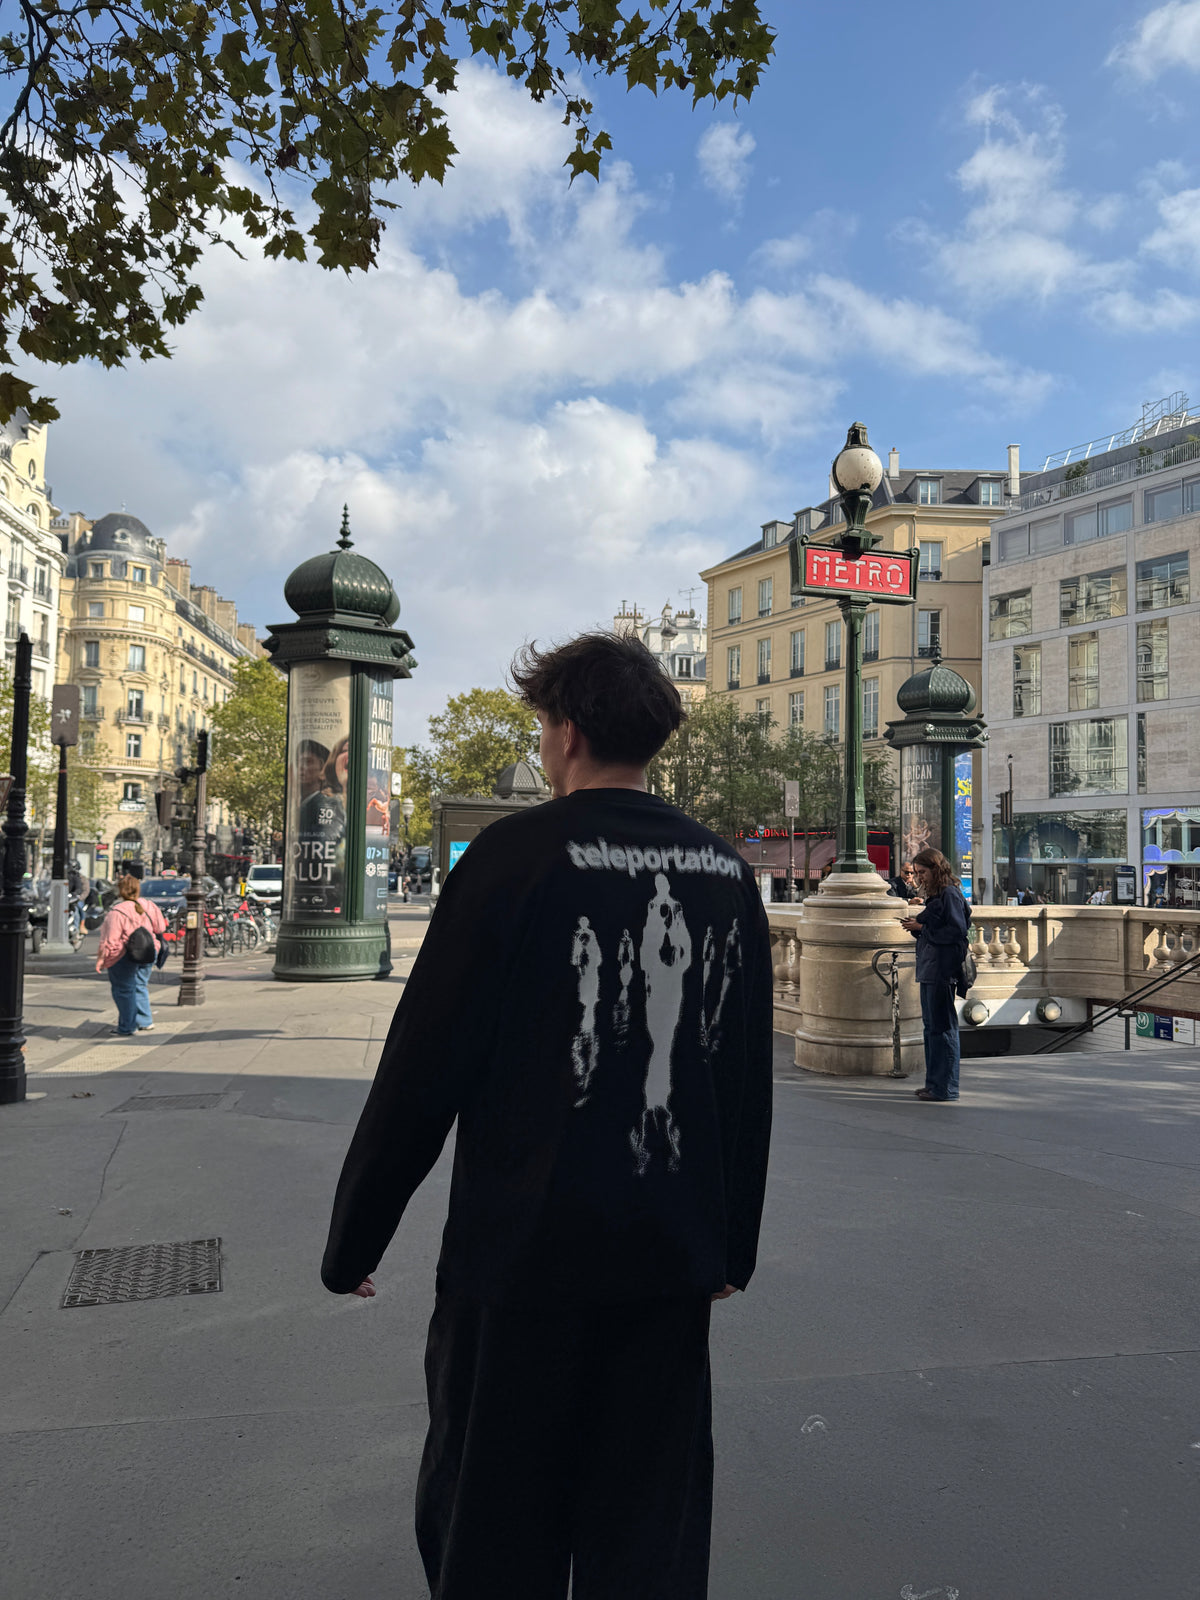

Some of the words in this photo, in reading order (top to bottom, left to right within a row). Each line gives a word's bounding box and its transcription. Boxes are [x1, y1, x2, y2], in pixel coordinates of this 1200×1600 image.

[812, 554, 904, 589] METRO
[319, 808, 334, 819] 30
[748, 828, 789, 838] CADINAL
[293, 840, 337, 860] OTRE
[566, 836, 742, 880] teleportation
[290, 862, 337, 882] ALUT
